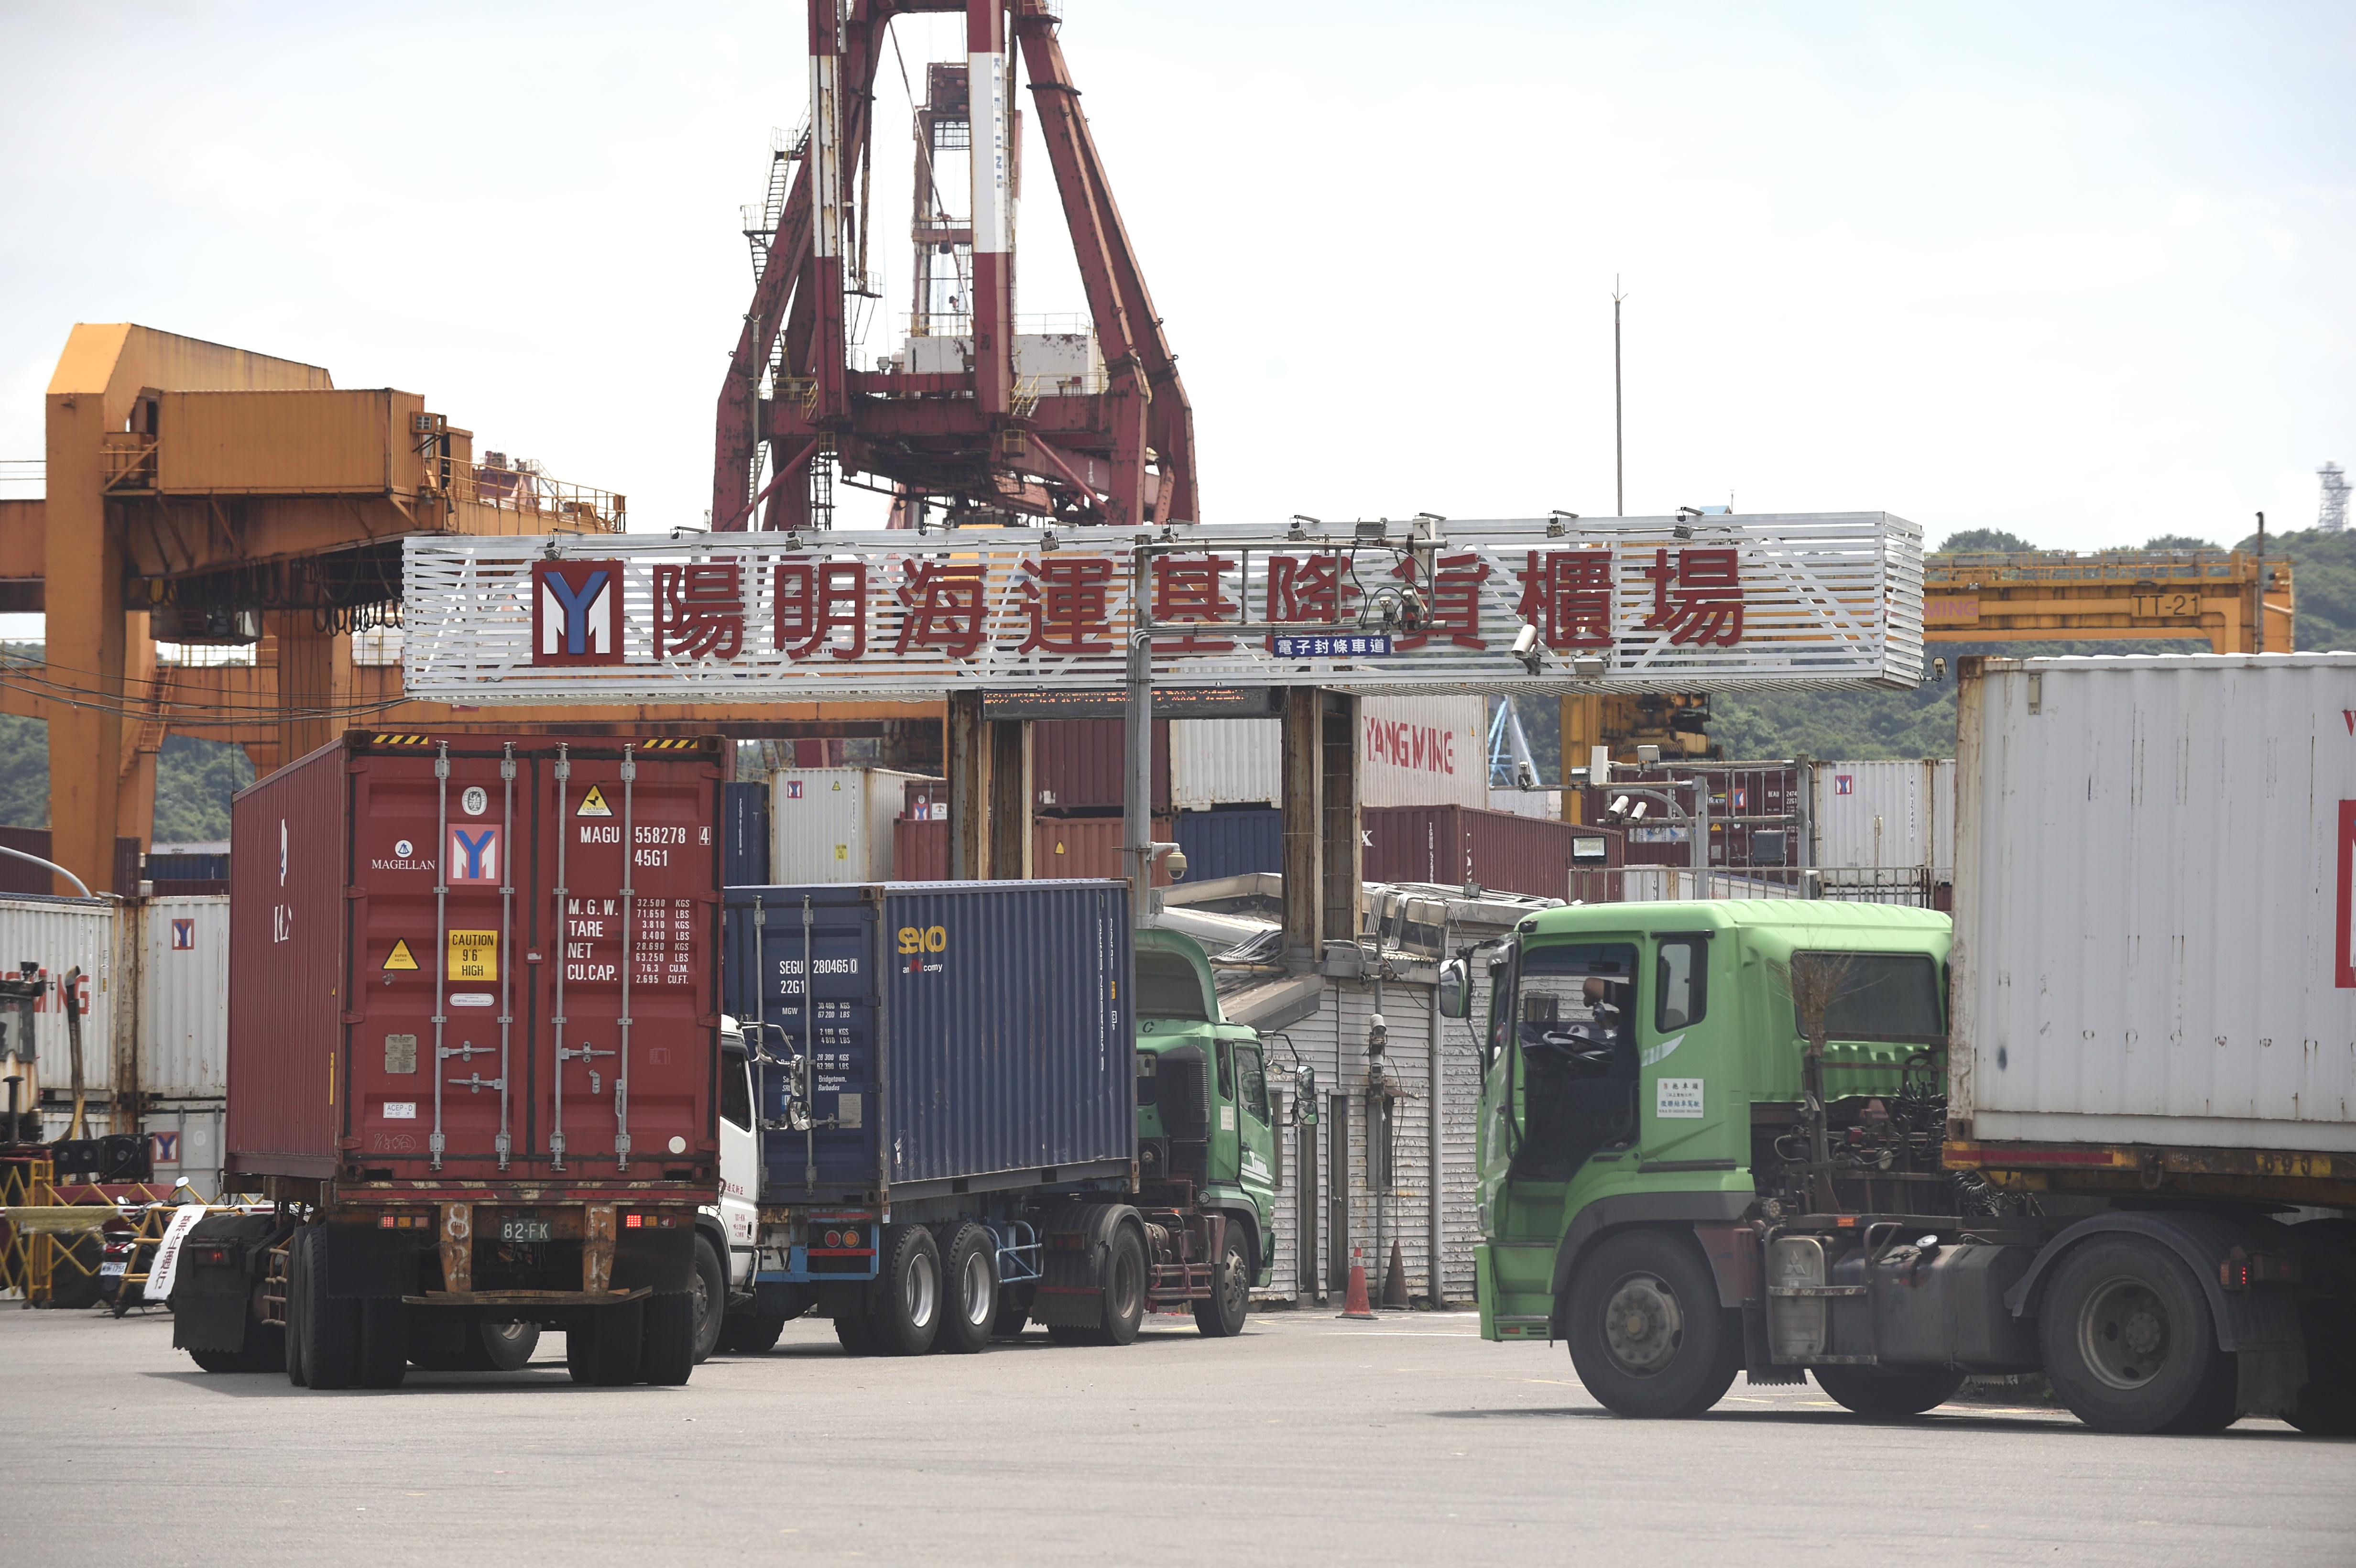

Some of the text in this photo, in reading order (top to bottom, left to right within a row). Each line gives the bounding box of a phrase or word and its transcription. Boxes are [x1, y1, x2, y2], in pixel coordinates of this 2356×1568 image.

[653, 548, 1744, 660] 陽明海運基隆貨櫃場
[1924, 601, 1978, 617] MING
[2133, 595, 2198, 616] TT-21
[1277, 638, 1385, 655] 電子封條車道
[1363, 716, 1409, 767] YANG
[580, 827, 709, 844] MAGU 558278 4
[371, 859, 436, 870] MAGELLAN
[634, 849, 668, 866] 45G1
[637, 899, 665, 907] 32.500
[676, 899, 690, 907] KGS
[637, 909, 689, 918] 71.650 LBS
[568, 921, 603, 937] TARE
[675, 921, 689, 929] KGS
[643, 931, 689, 940] 8.400 LBS
[452, 935, 494, 946] CAUTION
[567, 943, 594, 958] NET
[675, 943, 689, 951] KGS
[636, 953, 688, 962] 63.250 LBS
[462, 965, 483, 976] HIGH
[567, 964, 688, 980] CU.CAP. 76.3 CU.M.
[780, 959, 857, 974] SEGU 280465 0
[636, 975, 688, 984] 2.695 CU.FT.
[781, 980, 805, 993] 22G1
[818, 1075, 847, 1083] Bridgetown,
[154, 1214, 192, 1290] 禁止通行
